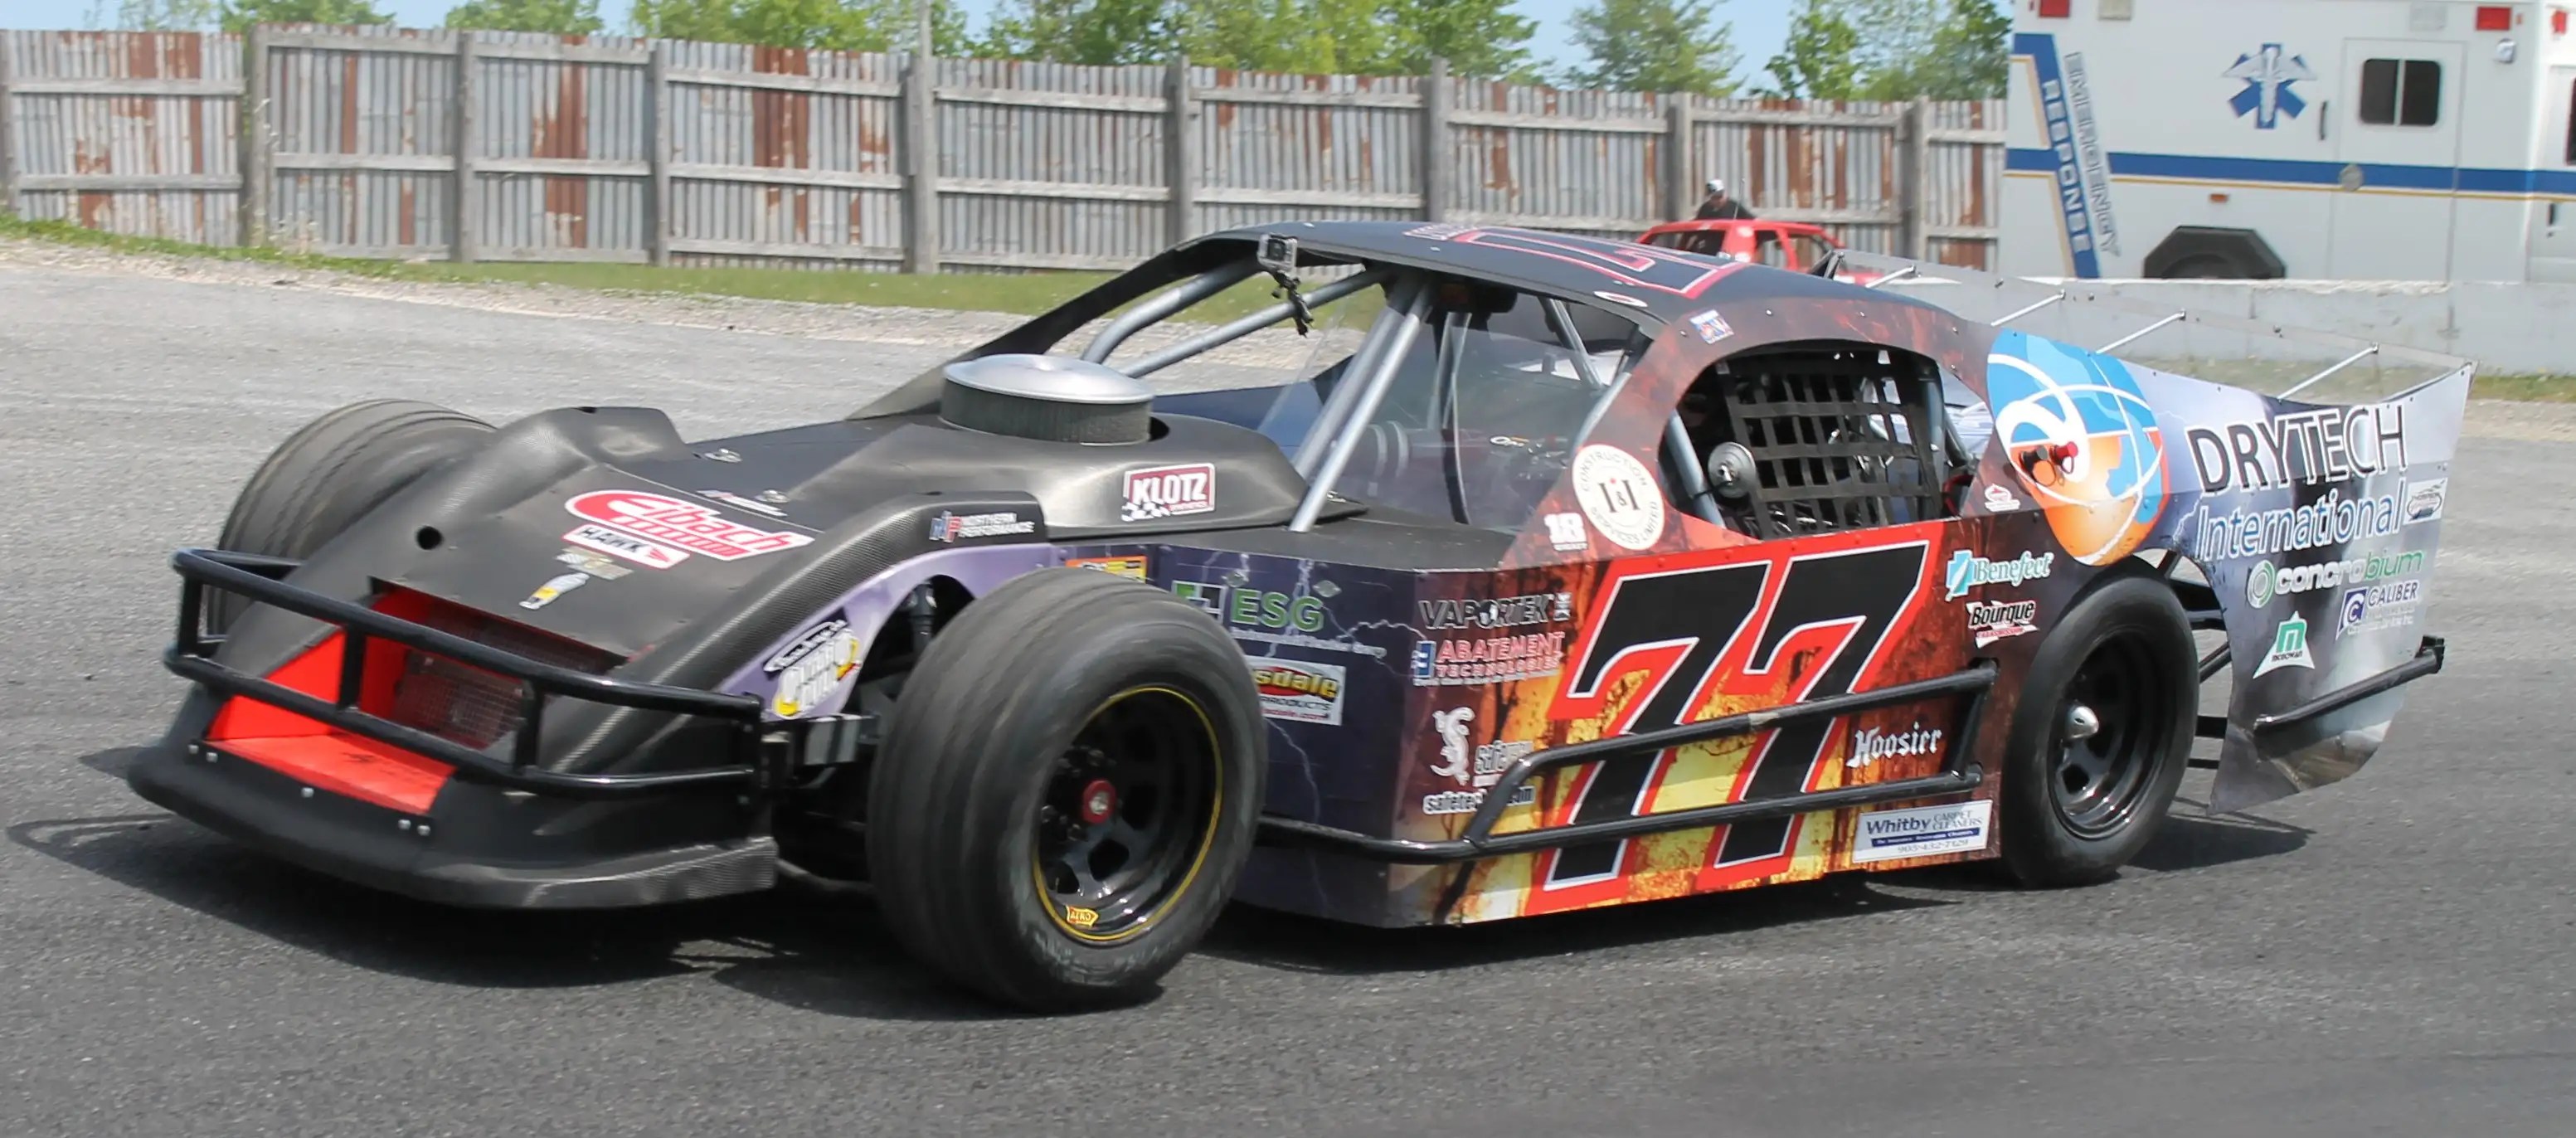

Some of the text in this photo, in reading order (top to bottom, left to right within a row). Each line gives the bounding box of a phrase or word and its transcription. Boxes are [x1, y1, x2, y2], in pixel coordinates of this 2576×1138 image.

[2185, 403, 2407, 497] DRYTECH
[1132, 472, 1208, 506] KLOTZ
[2194, 477, 2406, 562] International
[1974, 551, 2054, 586] Benefect
[2275, 550, 2425, 595] concrobium
[1232, 588, 1324, 632] ESG
[2367, 580, 2419, 608] CALIBER
[1418, 594, 1556, 630] VAPORTEK
[1969, 601, 2036, 628] Bourque
[1436, 631, 1566, 663] ABATEMENT
[1252, 669, 1339, 700] sdale
[1538, 537, 1932, 894] 77
[1845, 720, 1942, 768] Hoosier
[1867, 816, 1932, 834] Whitby
